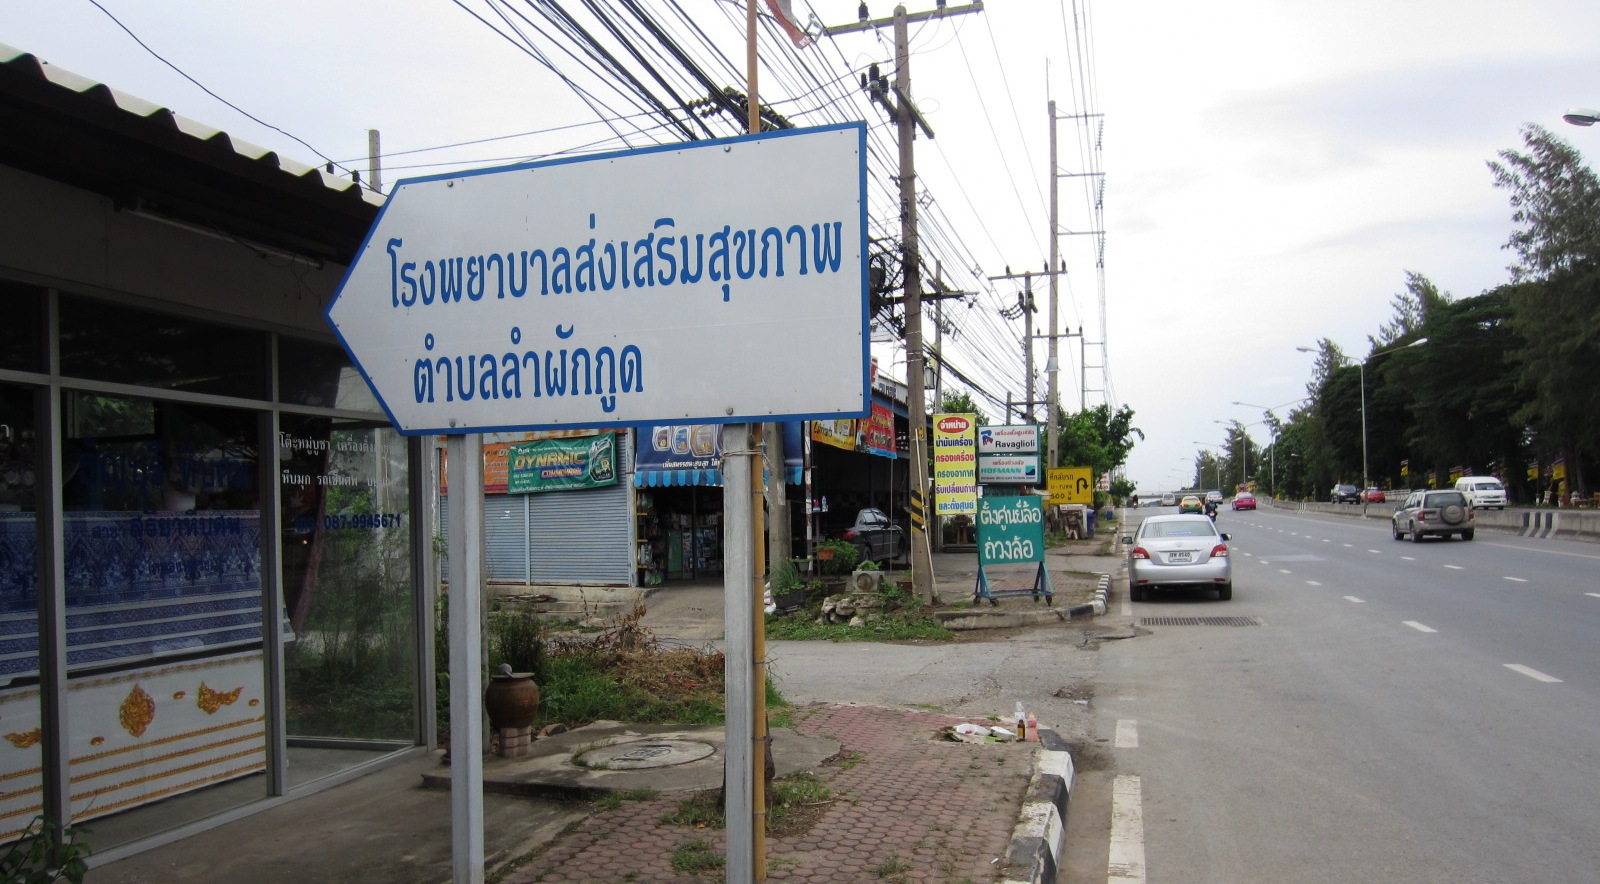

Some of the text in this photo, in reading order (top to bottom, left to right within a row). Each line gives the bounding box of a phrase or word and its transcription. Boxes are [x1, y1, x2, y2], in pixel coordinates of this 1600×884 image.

[386, 212, 844, 308] โรงพยาบาลส่งเสริมสุขภาพ
[413, 324, 644, 413] ตำบลลำผักกูด
[940, 418, 967, 430] จำหน่าย
[279, 431, 331, 456] โต๊ะหมู่บูชา
[936, 434, 973, 447] น้ำมันเครื่อง
[995, 439, 1035, 450] Ravaglioli
[514, 451, 587, 470] DYNAMIC
[935, 450, 975, 462] กรองเครื่อง
[937, 469, 974, 479] กรองอากาศ
[323, 513, 402, 531] 087-9945671
[980, 499, 1042, 531] ตั้งศูนย์ล้อ
[985, 535, 1034, 560] ถ่วงล้อ
